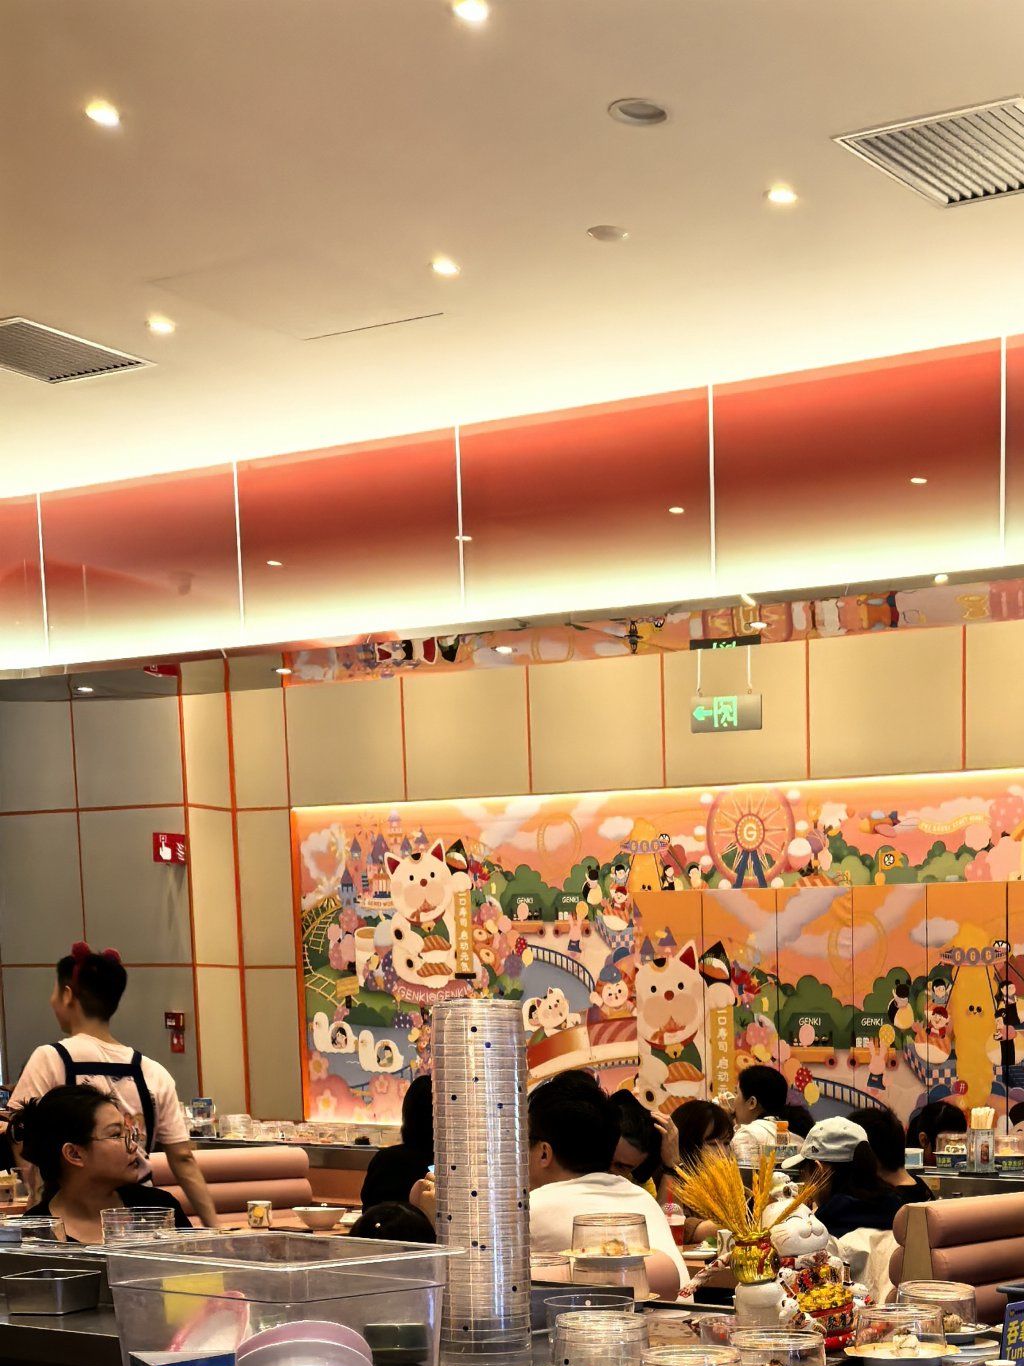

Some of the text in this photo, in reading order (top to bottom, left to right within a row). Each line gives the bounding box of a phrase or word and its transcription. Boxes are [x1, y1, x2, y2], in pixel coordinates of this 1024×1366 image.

[743, 825, 757, 841] G
[799, 1017, 822, 1026] GENKI
[861, 1017, 883, 1026] GENKI
[716, 1009, 729, 1053] 一口寿司
